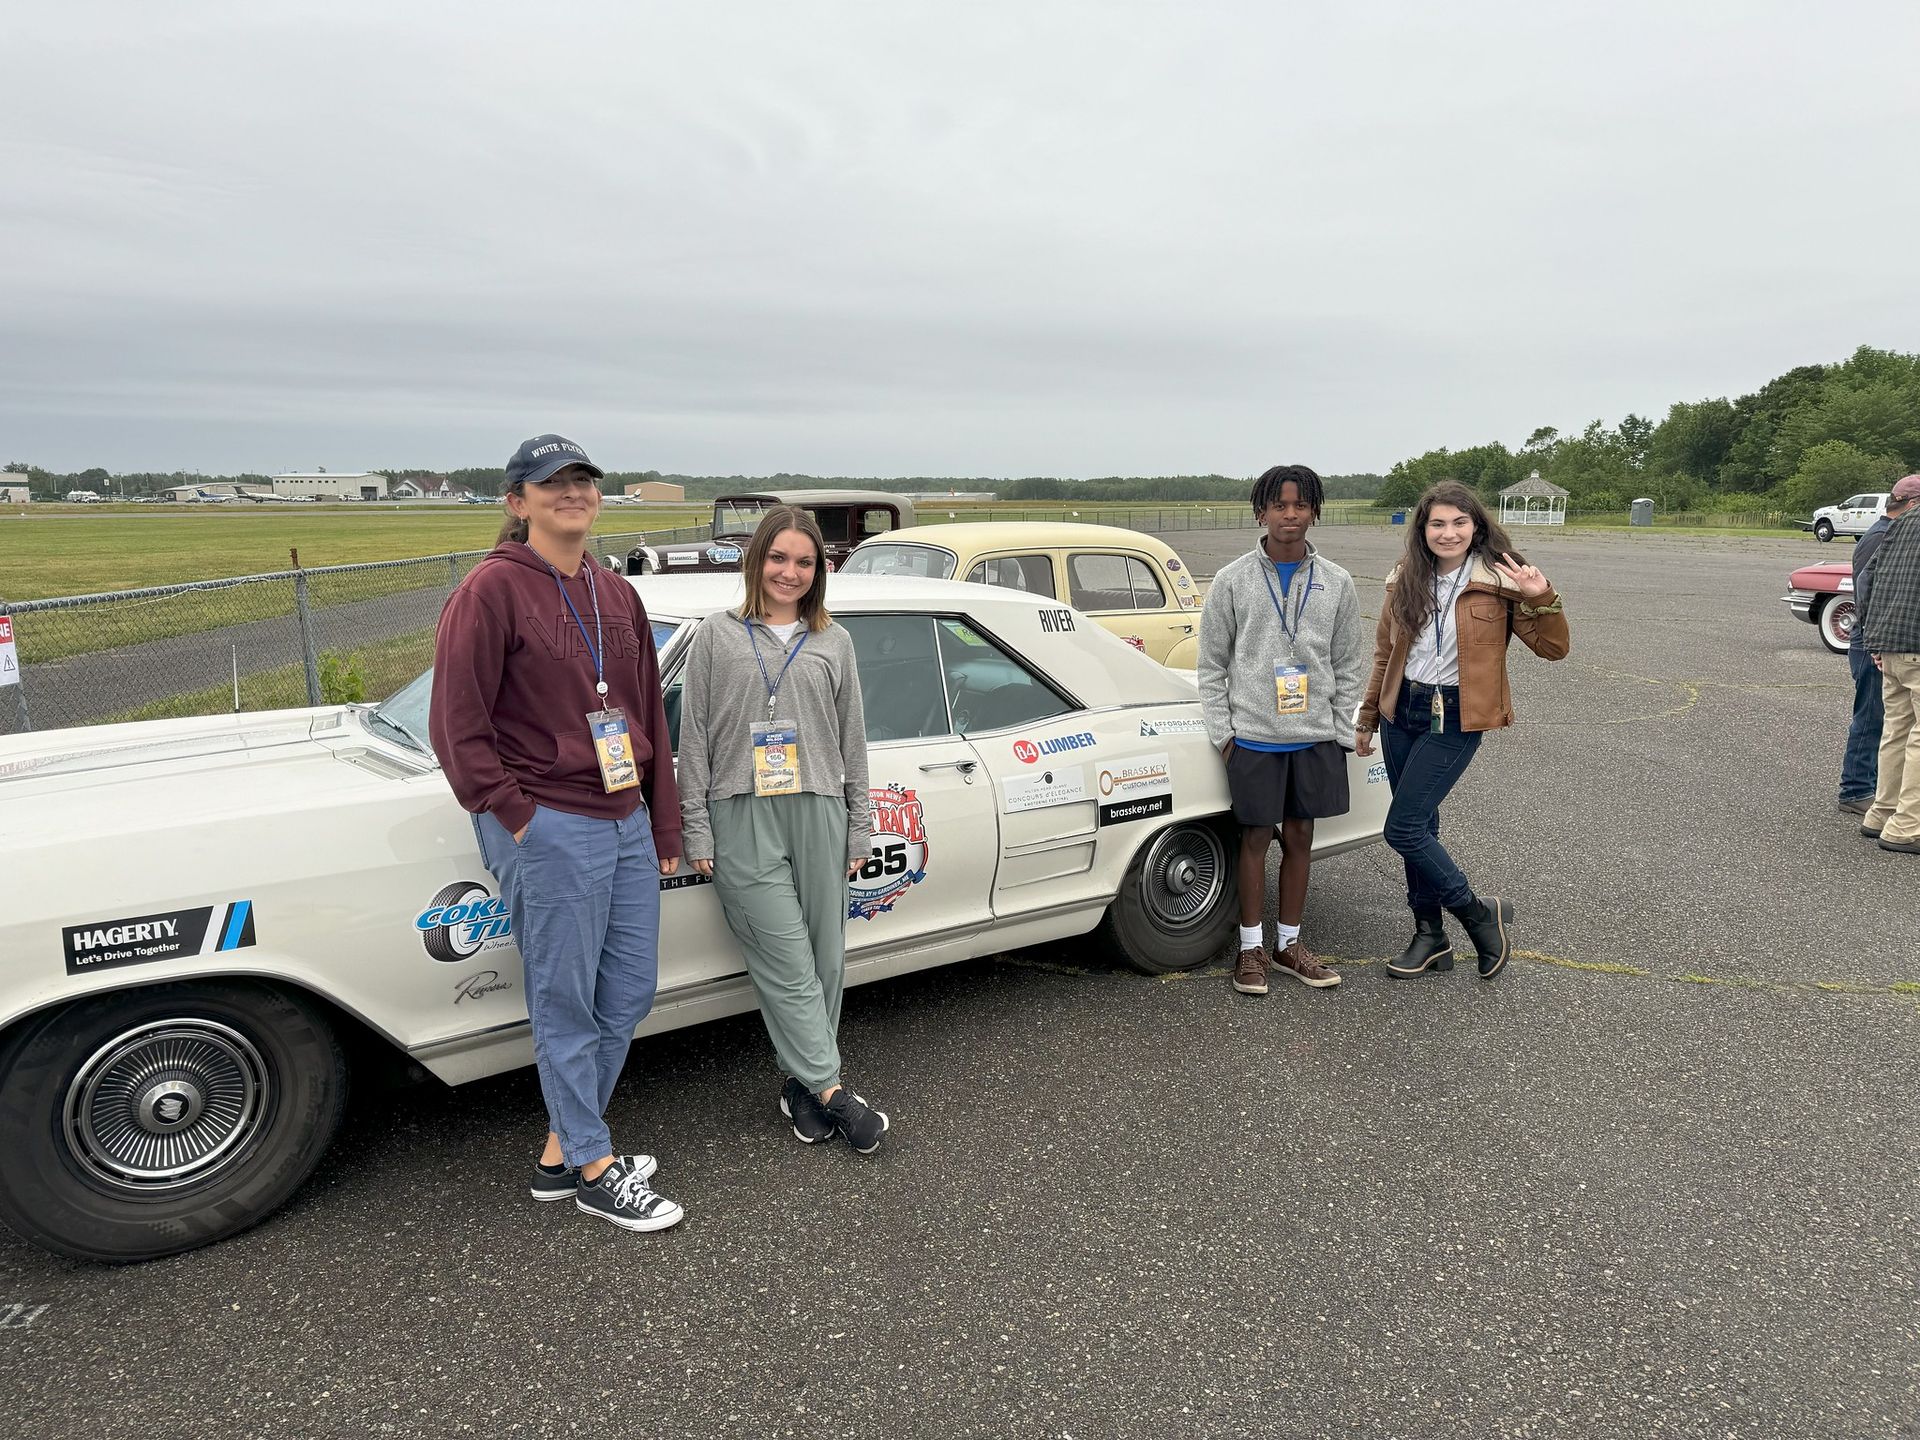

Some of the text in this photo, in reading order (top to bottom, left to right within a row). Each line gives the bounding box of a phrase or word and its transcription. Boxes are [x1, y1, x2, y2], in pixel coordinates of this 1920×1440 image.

[531, 443, 560, 458] WHITE
[1038, 609, 1076, 633] RIVER
[526, 615, 641, 660] VANS
[1014, 732, 1097, 761] 84 LUMBER
[1122, 763, 1167, 778] BRASS KEY
[1367, 766, 1386, 777] McCo
[1122, 776, 1170, 790] CUSTOM HOMES
[869, 791, 885, 799] OTOR
[1008, 793, 1043, 804] CONCOURS
[1110, 800, 1163, 819] brasskey.net
[879, 802, 923, 842] RACE
[849, 842, 907, 883] 65
[661, 877, 688, 889] THE
[75, 943, 181, 966] Let's Drive Together
